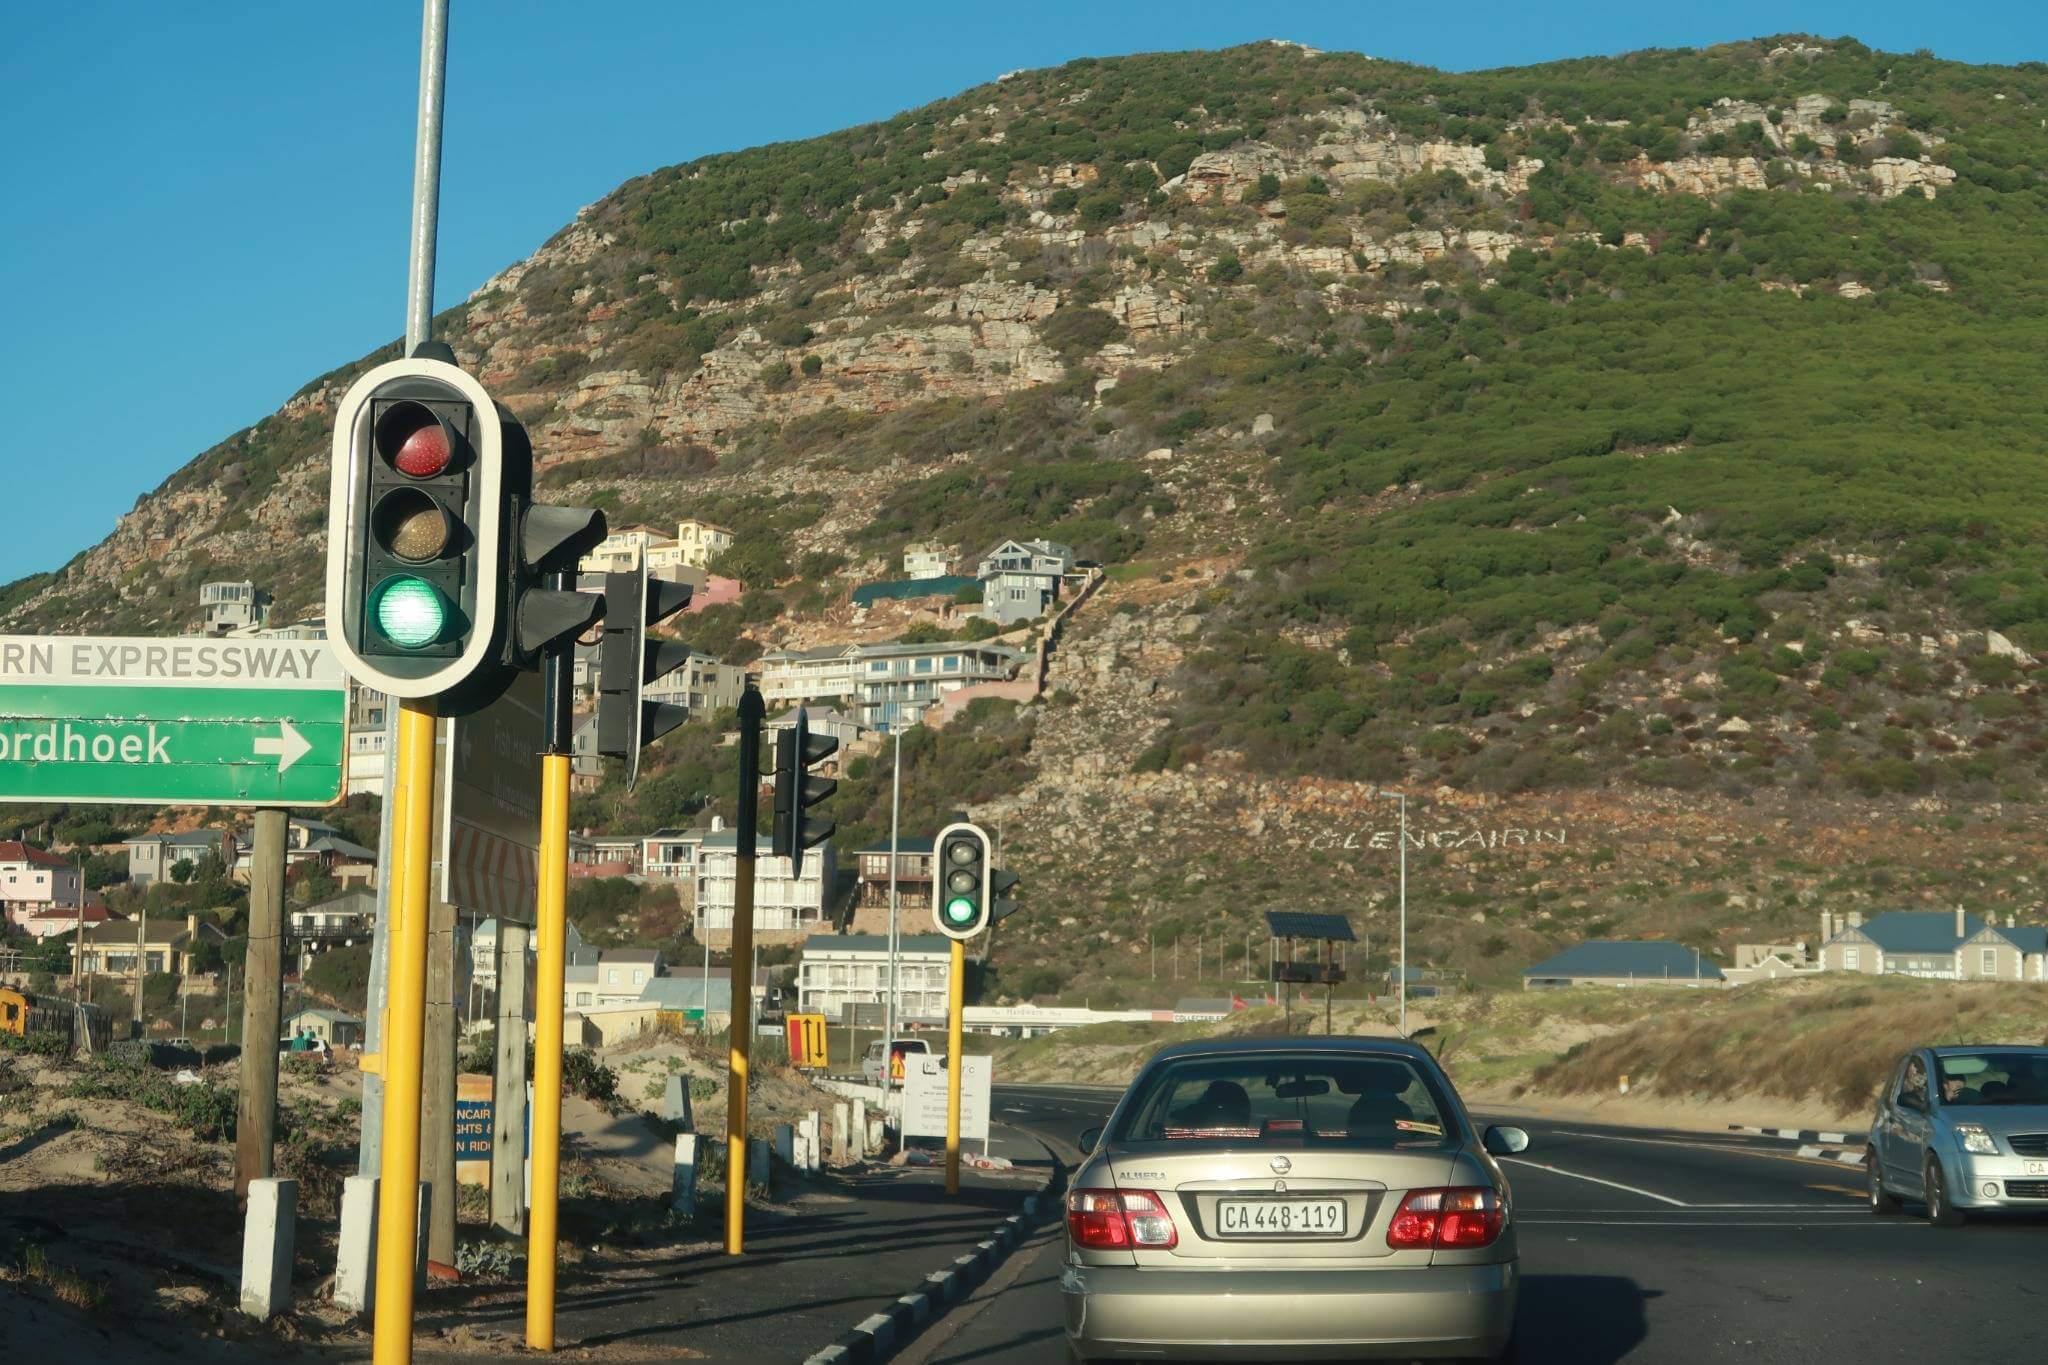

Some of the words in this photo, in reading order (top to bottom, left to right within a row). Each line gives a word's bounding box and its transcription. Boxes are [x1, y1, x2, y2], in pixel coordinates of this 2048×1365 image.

[2, 643, 54, 674] RN
[71, 645, 320, 679] EXPRESSWAY
[1308, 829, 1567, 850] GLENCAIRN
[469, 1141, 490, 1151] RID
[1119, 1171, 1168, 1181] ALMERA
[2029, 1163, 2045, 1174] CA
[1225, 1205, 1249, 1229] CA
[1255, 1205, 1337, 1229] 448-119
